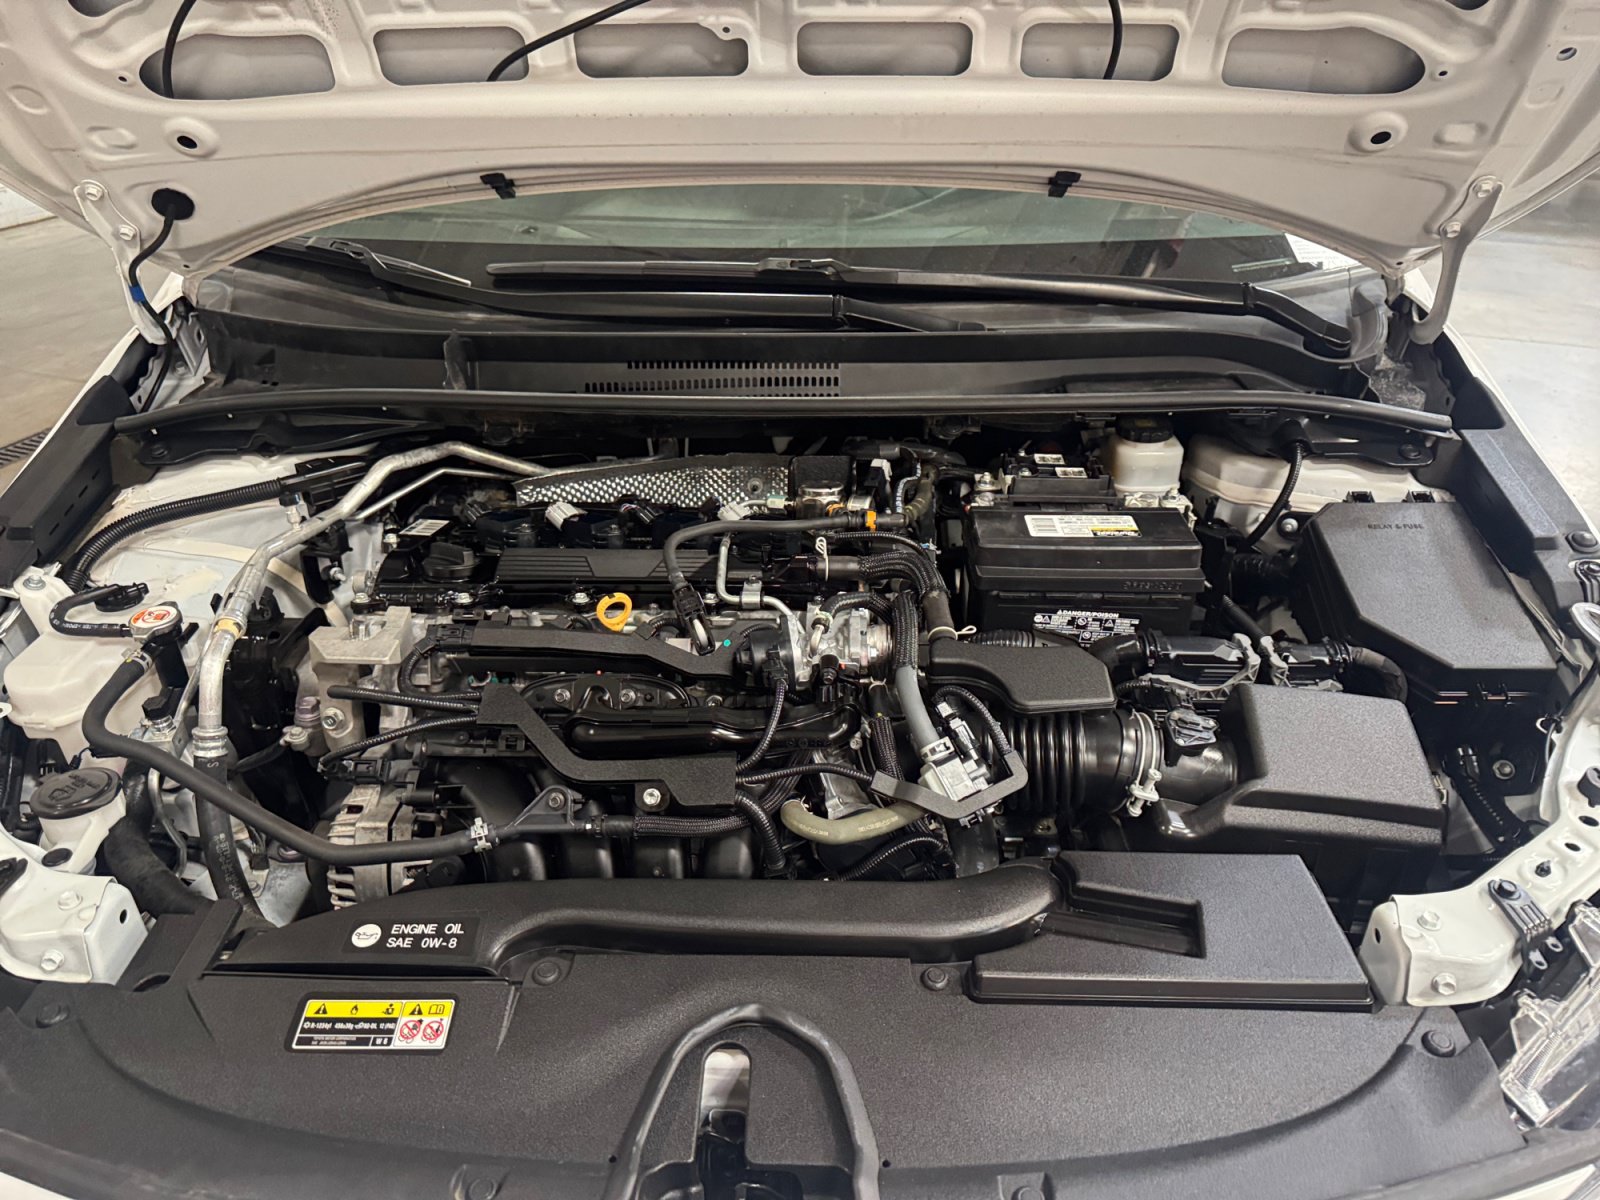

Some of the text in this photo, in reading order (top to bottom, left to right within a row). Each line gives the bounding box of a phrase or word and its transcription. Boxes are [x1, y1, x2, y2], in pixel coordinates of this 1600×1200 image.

[391, 923, 464, 934] ENGINE OIL
[386, 937, 457, 949] SAE 0W-8
